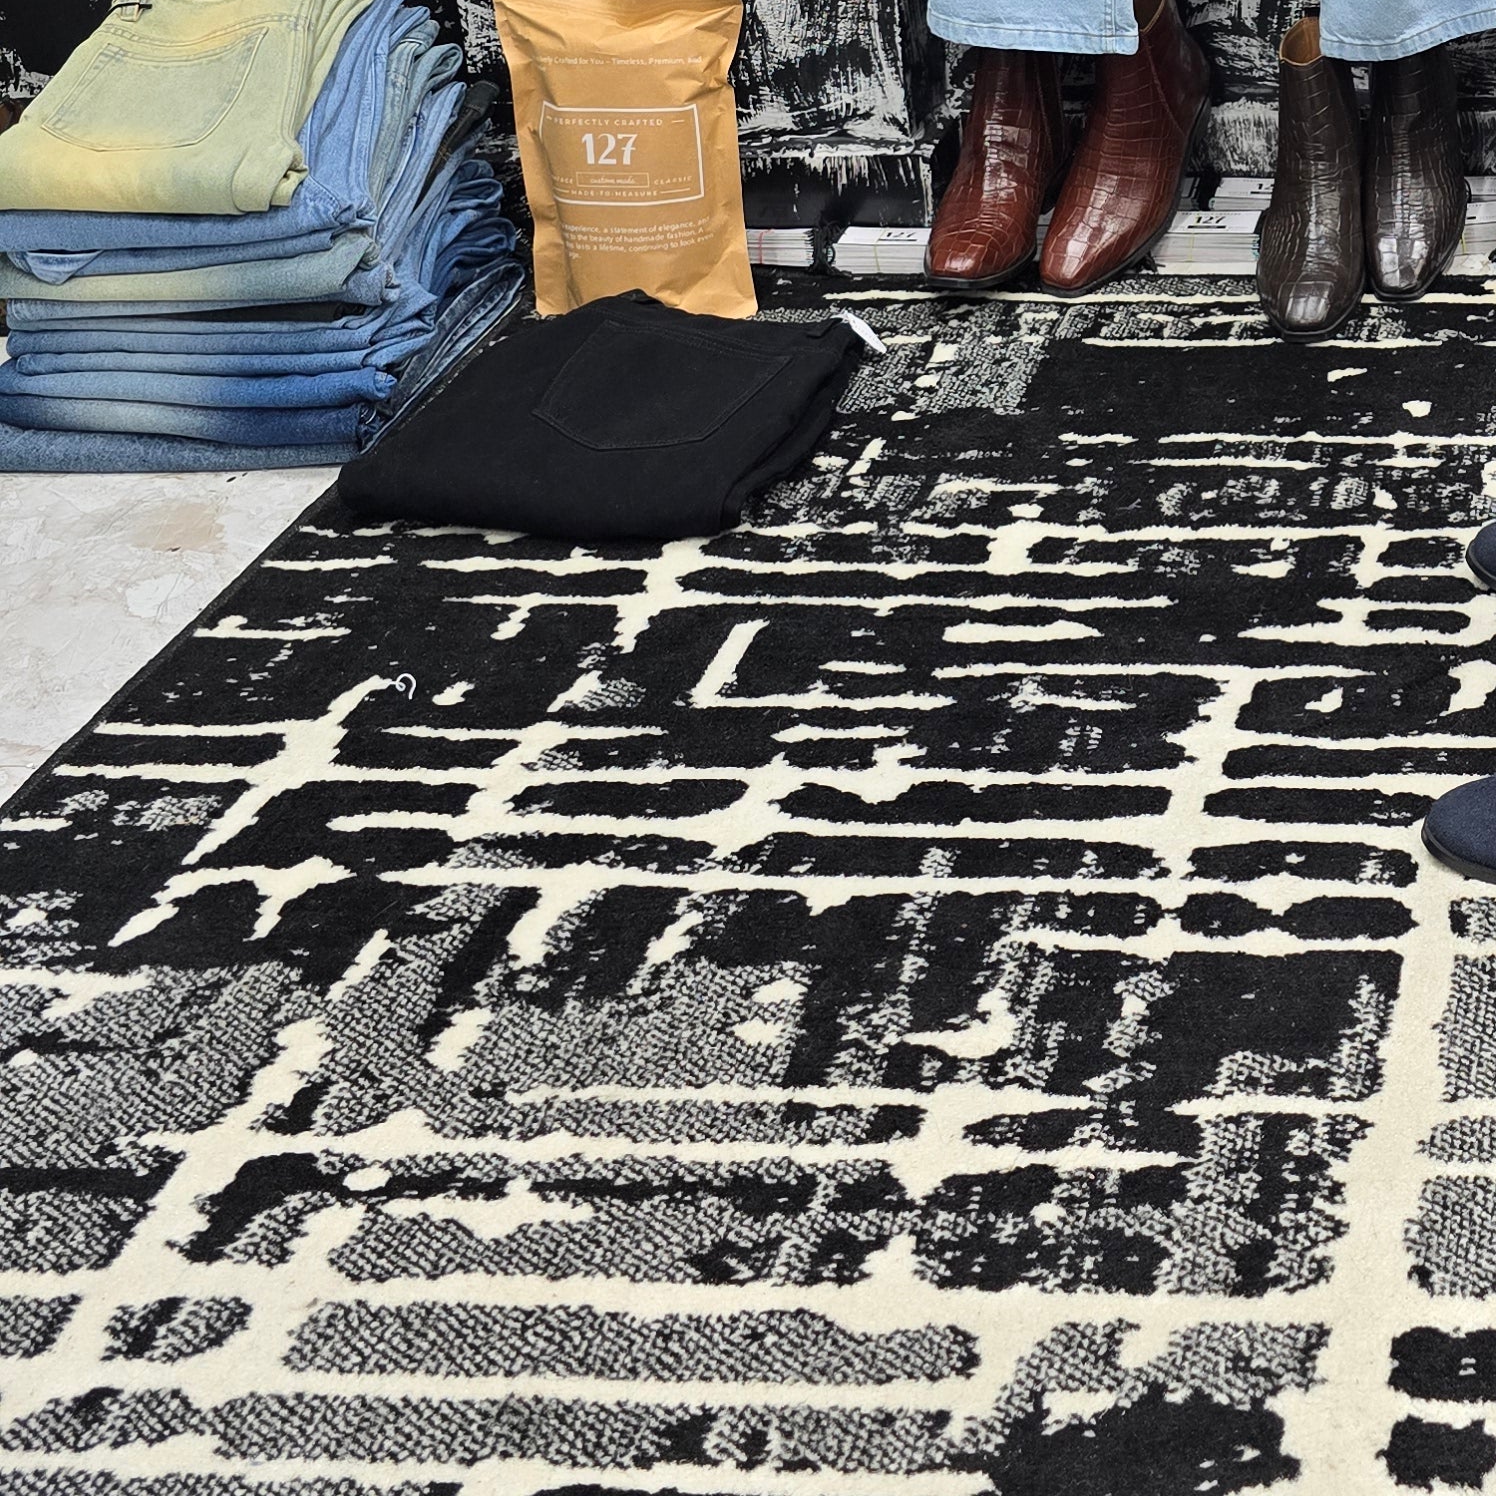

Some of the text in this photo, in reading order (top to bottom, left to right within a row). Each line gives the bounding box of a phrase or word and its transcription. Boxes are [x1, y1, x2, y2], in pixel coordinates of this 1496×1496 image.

[554, 117, 609, 126] PERFECTLY
[581, 132, 638, 166] 127
[1196, 216, 1226, 224] 127
